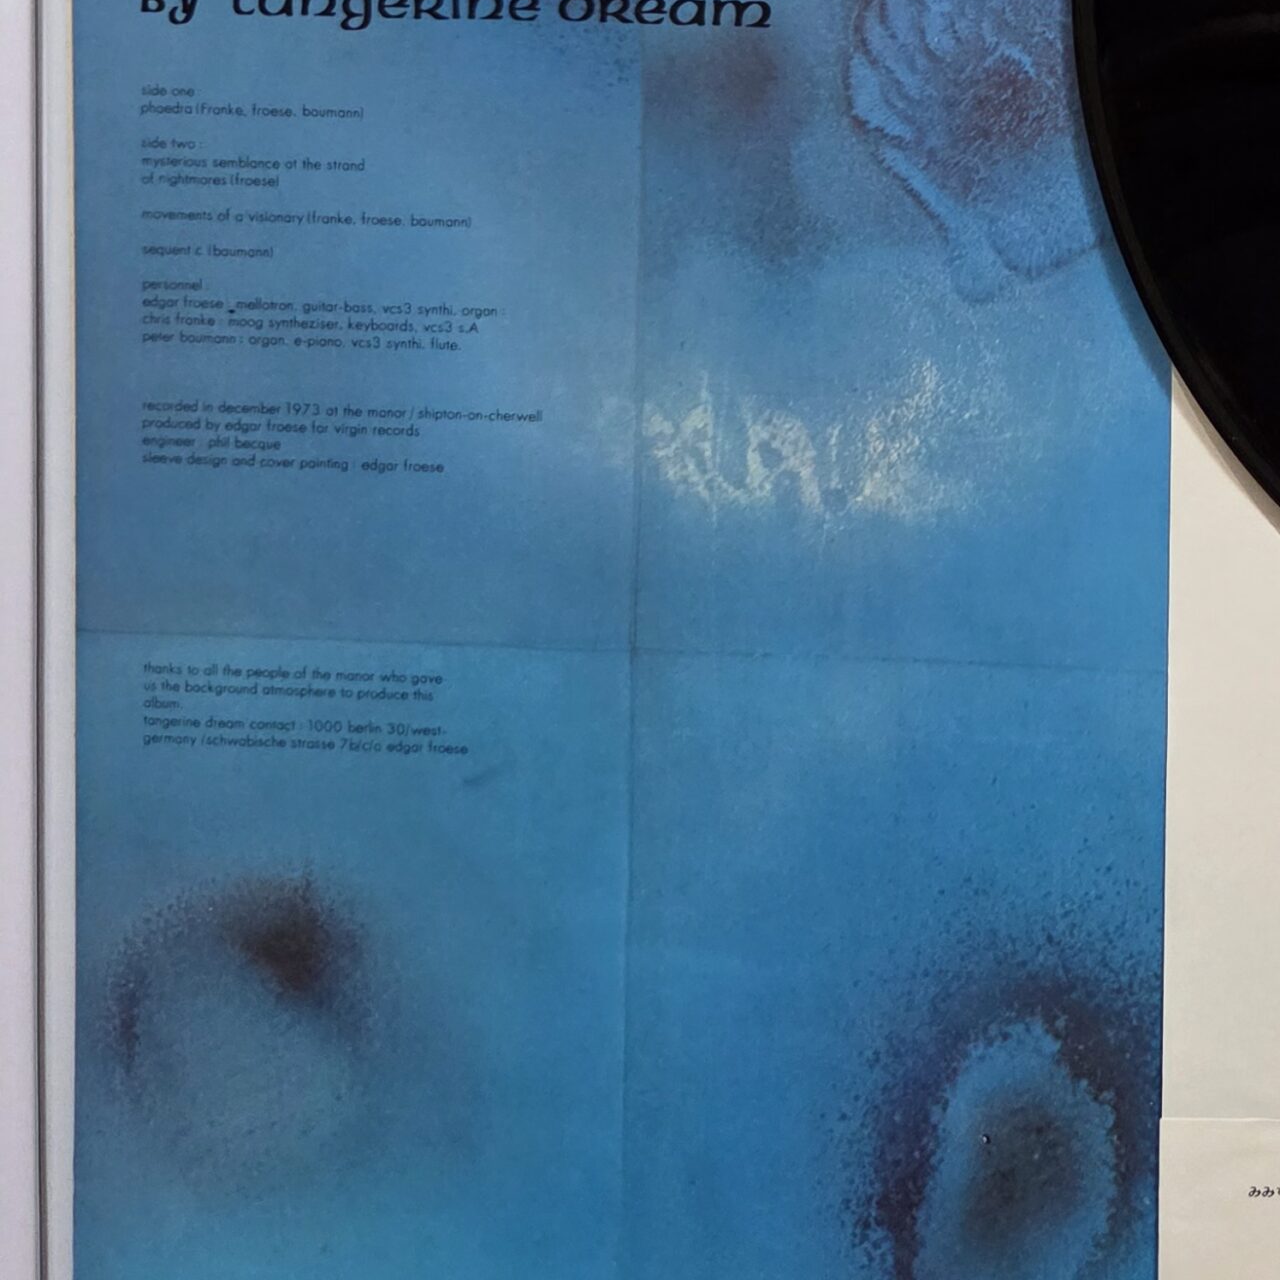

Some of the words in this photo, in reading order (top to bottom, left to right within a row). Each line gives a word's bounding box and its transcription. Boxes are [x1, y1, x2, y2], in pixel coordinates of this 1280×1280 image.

[141, 83, 168, 97] side
[139, 100, 192, 117] phaedra
[141, 156, 207, 169] mysterious
[212, 157, 280, 170] semblance
[284, 159, 299, 170] at
[302, 157, 322, 170] the
[326, 158, 366, 172] strand
[140, 173, 155, 185] of
[158, 173, 227, 187] nightmares
[142, 296, 179, 310] edgar
[183, 296, 224, 309] froese
[382, 302, 412, 315] vcs3
[142, 332, 175, 344] peter
[351, 337, 381, 349] vcs3
[142, 398, 199, 413] recorded
[203, 400, 214, 413] in
[218, 399, 281, 415] december
[286, 402, 321, 416] 1973
[326, 406, 339, 417] at
[343, 403, 363, 417] the
[367, 407, 406, 419] manor
[142, 416, 201, 430] produced
[205, 418, 221, 432] by
[224, 419, 262, 434] edgar
[266, 419, 308, 433] froese
[311, 420, 329, 434] for
[334, 424, 368, 438] virgin
[372, 424, 420, 437] records
[142, 435, 196, 448] engineer
[208, 436, 230, 449] phil
[234, 437, 282, 451] becque
[142, 452, 183, 464] sleeve
[186, 452, 228, 468] design
[231, 453, 255, 467] and
[259, 457, 296, 468] cover
[299, 455, 349, 472] painting
[361, 459, 399, 474] edgar
[403, 459, 444, 473] froese
[143, 661, 183, 675] thanks
[187, 663, 200, 676] to
[203, 664, 218, 676] all
[222, 664, 243, 677] the
[246, 665, 290, 680] people
[293, 665, 307, 679] of
[312, 667, 331, 681] the
[335, 671, 375, 682] manor
[380, 670, 407, 683] who
[411, 674, 443, 686] gave
[143, 680, 157, 692] us
[160, 679, 180, 692] the
[184, 680, 258, 696] background
[262, 684, 336, 699] atmosphere
[340, 688, 353, 698] to
[356, 687, 409, 701] produce
[413, 688, 434, 701] this
[143, 716, 201, 729] tangerine
[204, 716, 245, 729] dream
[249, 720, 296, 732] contact
[308, 719, 343, 733] 1000
[347, 720, 382, 733] berlin
